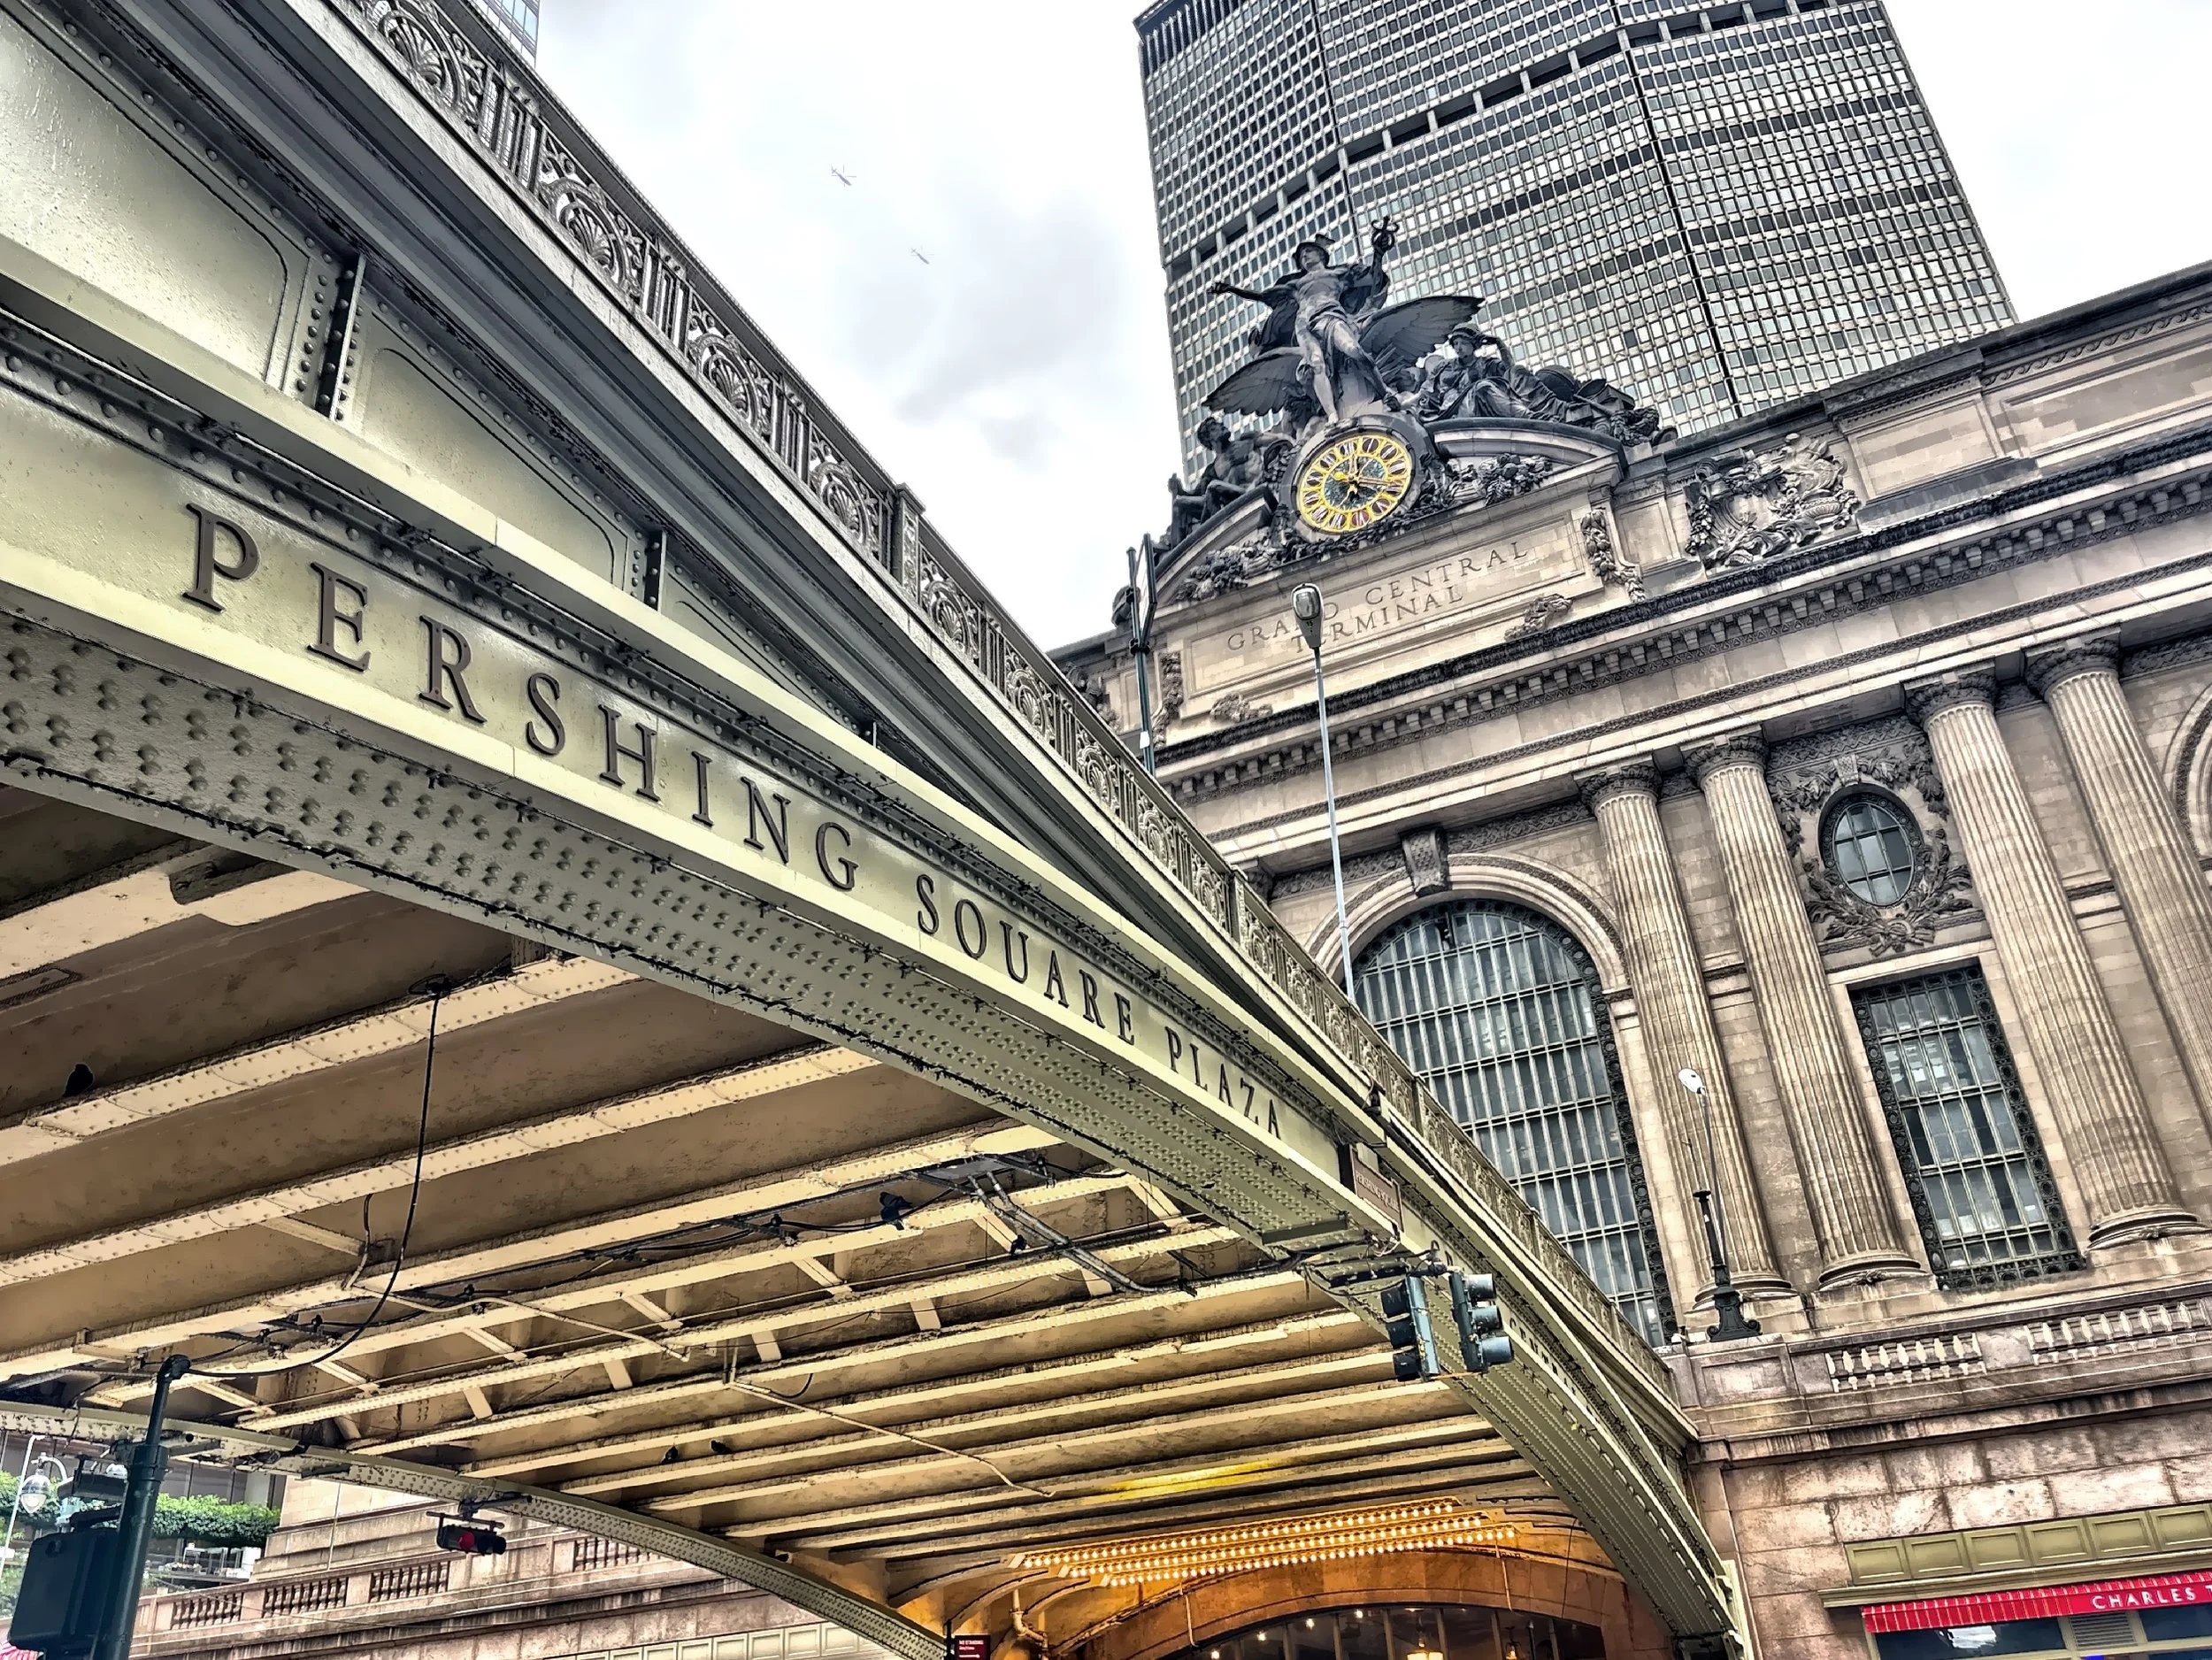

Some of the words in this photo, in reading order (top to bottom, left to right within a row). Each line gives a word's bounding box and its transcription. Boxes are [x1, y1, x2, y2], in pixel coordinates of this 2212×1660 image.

[1227, 602, 1339, 651] GRAD
[1365, 541, 1527, 605] CENTRAL
[1291, 586, 1463, 654] TRMINAL
[181, 503, 860, 891] PERSHING
[915, 873, 1135, 1046] SQUARE
[1164, 1026, 1282, 1141] PLAZA
[2092, 1587, 2195, 1610] CHARLES
